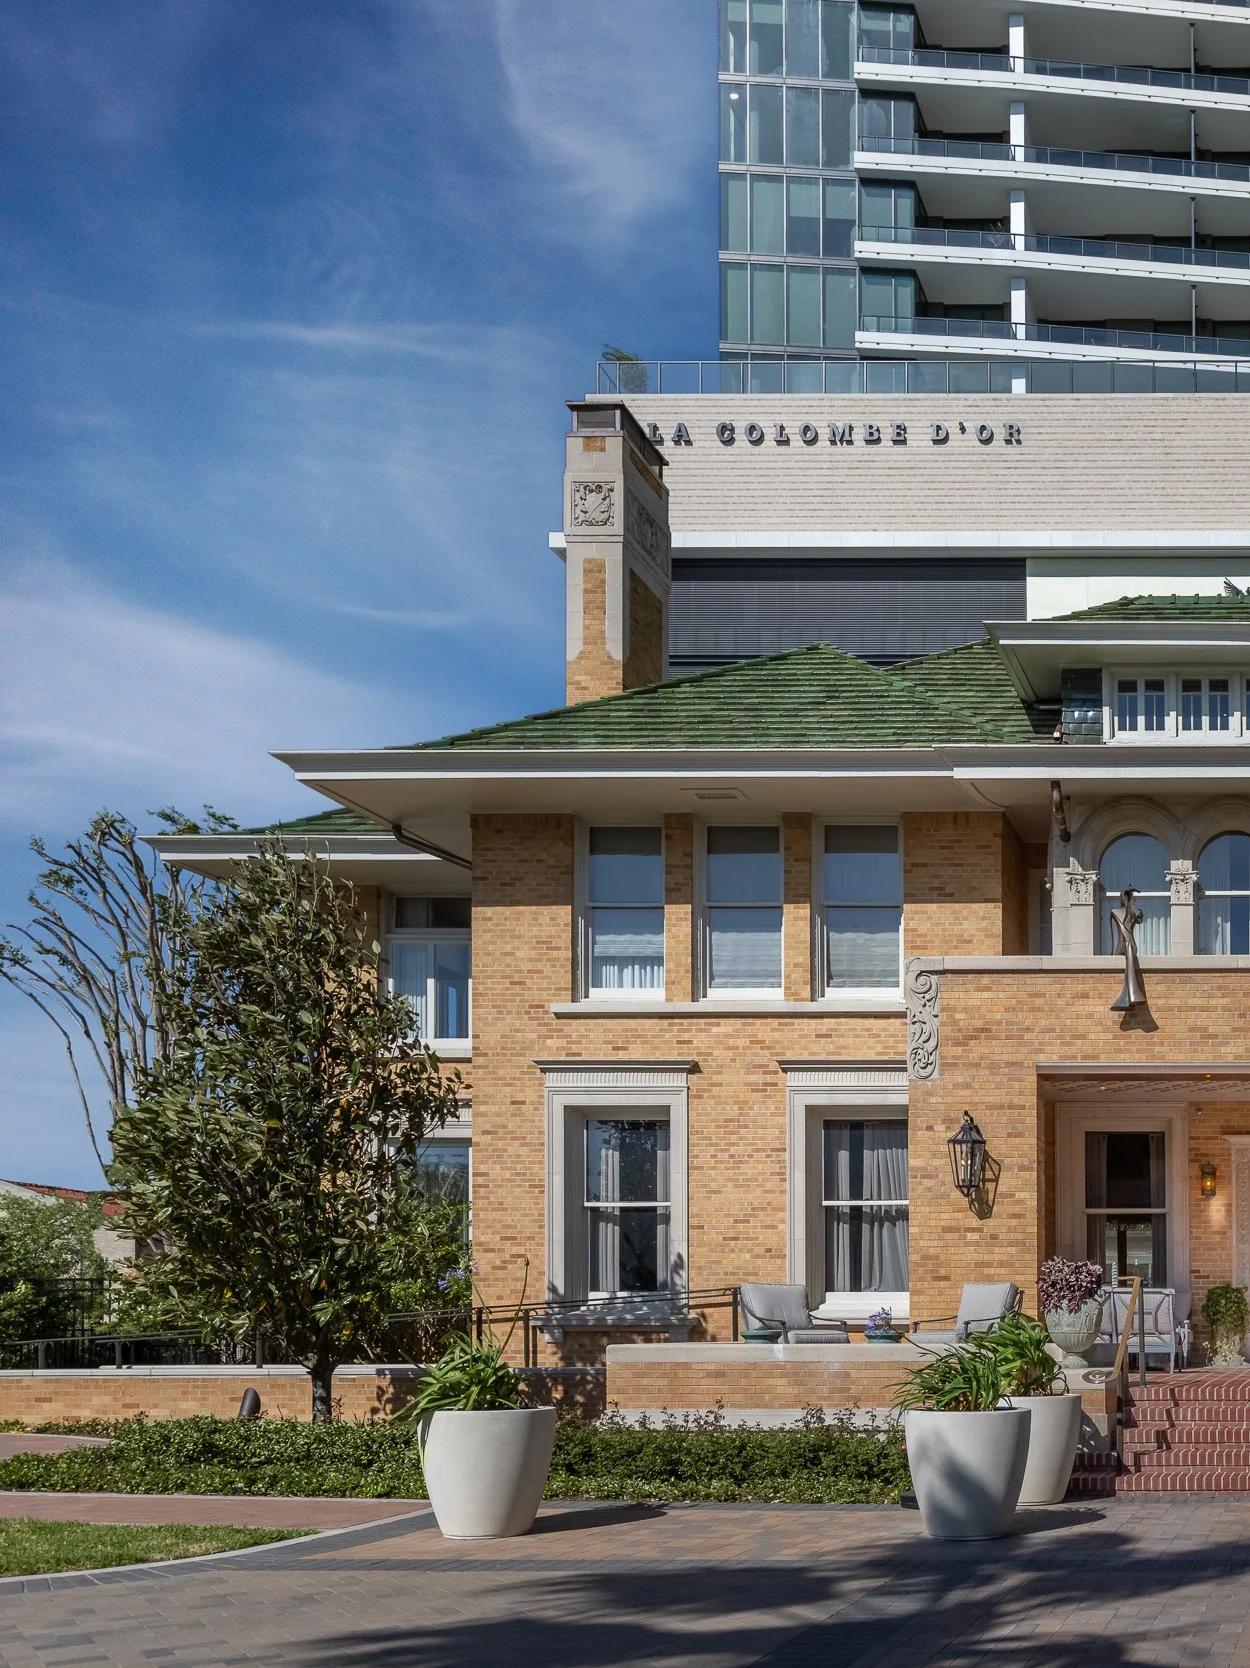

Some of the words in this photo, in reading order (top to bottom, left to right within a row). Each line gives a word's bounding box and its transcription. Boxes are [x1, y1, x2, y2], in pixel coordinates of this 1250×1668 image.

[646, 422, 692, 443] LA
[716, 421, 906, 443] COLOMBE
[930, 422, 1021, 443] D'OR
